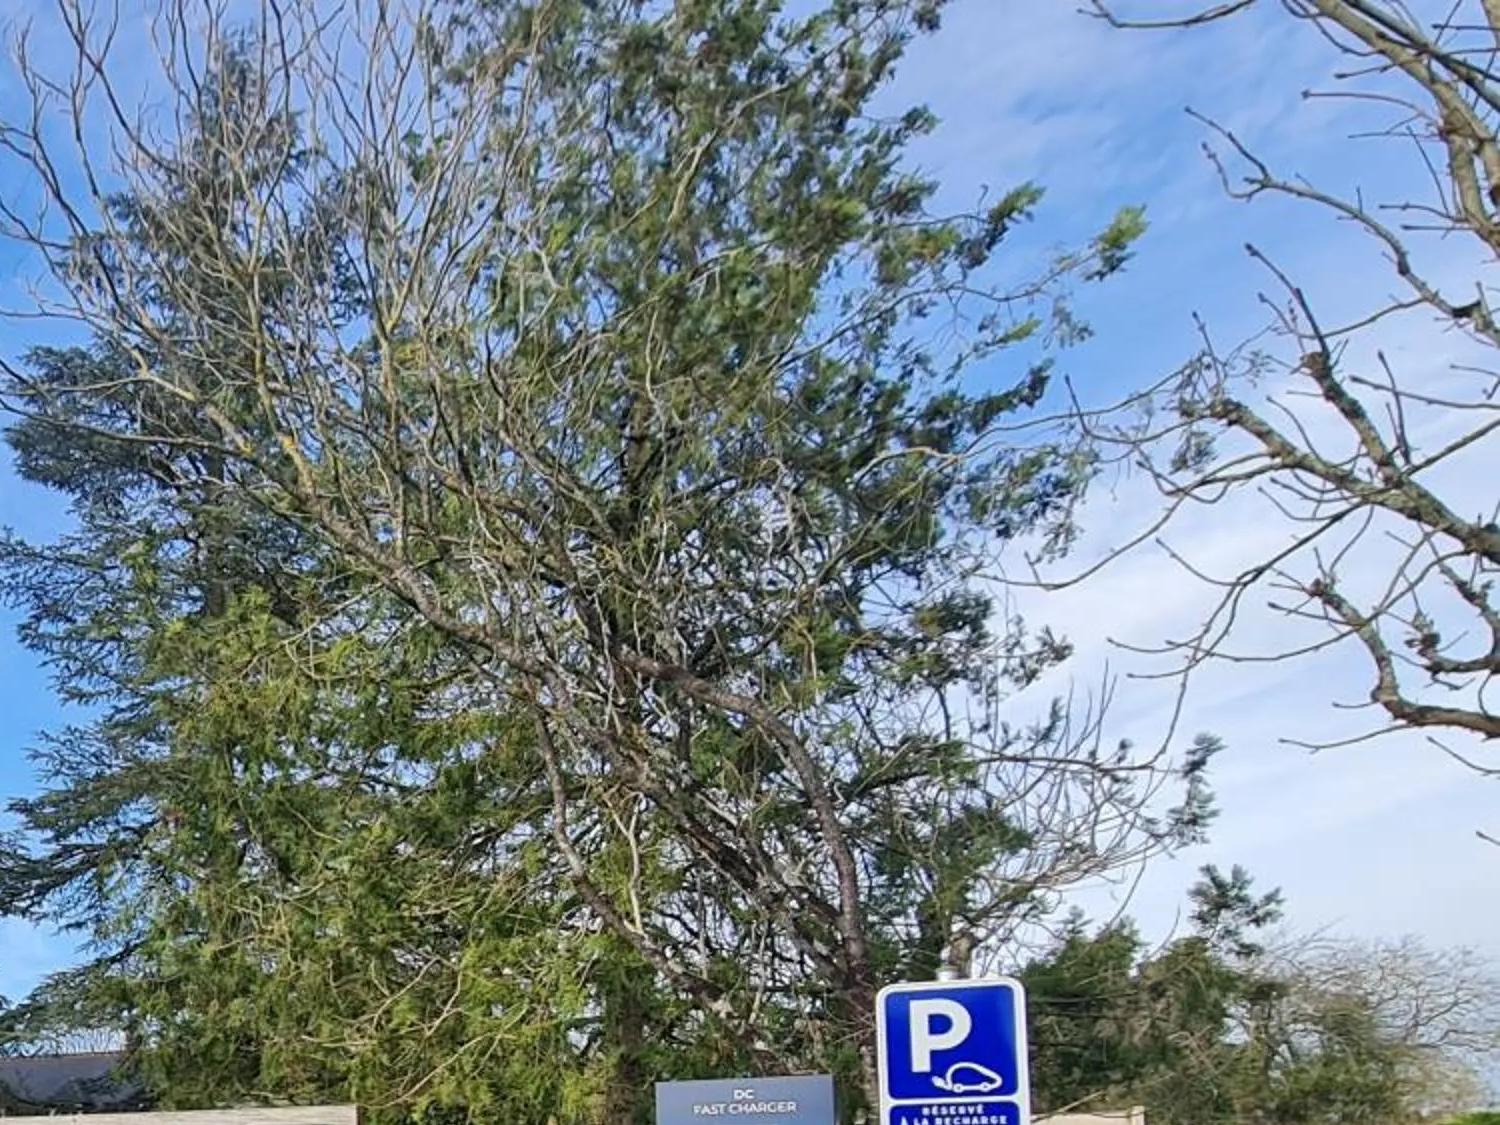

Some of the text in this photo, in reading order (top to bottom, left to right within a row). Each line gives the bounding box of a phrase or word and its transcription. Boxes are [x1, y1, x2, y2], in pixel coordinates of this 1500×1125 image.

[908, 998, 973, 1073] P
[733, 1089, 755, 1099] DC
[693, 1101, 798, 1115] FAST CHARGER
[935, 1115, 1008, 1125] RECHARGE
